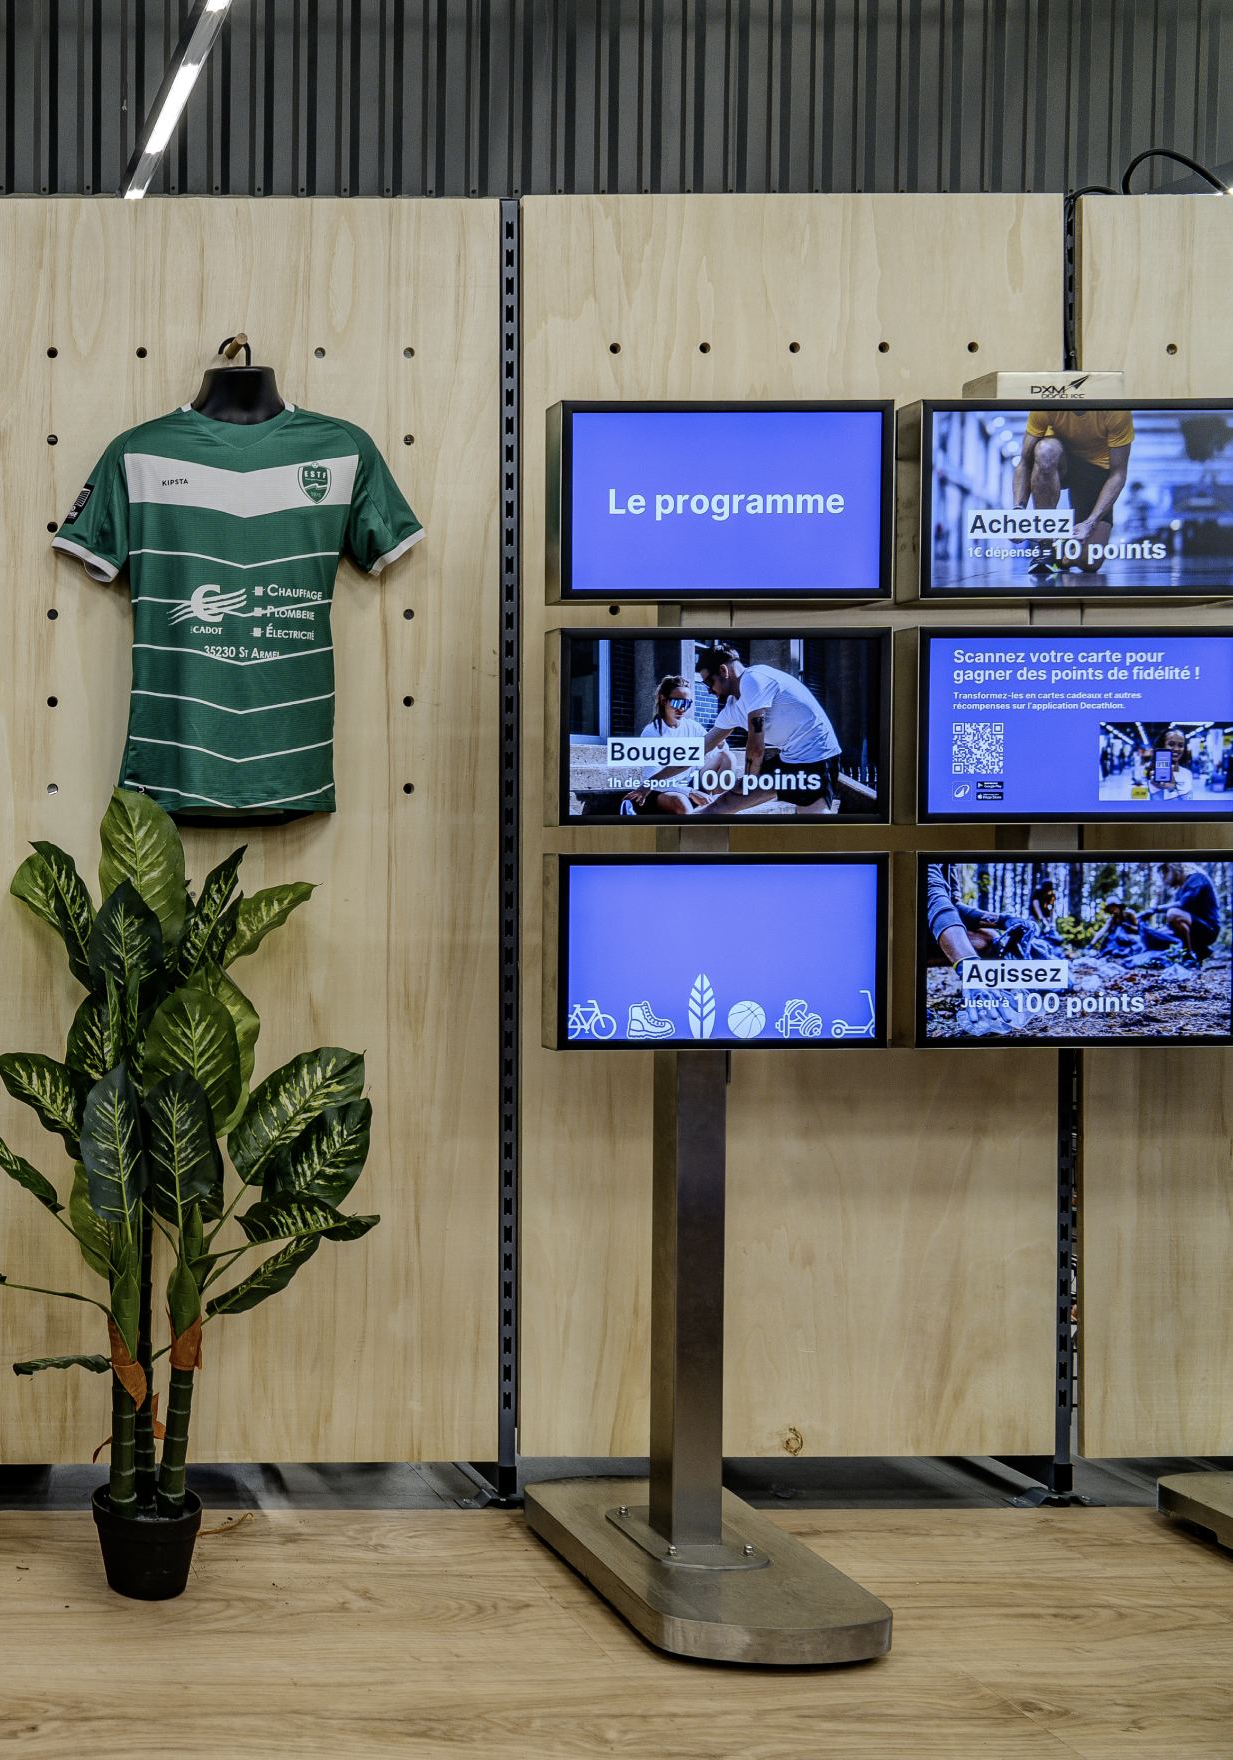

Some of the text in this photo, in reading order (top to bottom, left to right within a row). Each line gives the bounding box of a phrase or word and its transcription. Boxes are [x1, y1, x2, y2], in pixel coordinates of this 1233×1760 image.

[609, 488, 844, 522] Le programme
[970, 514, 1070, 534] Achetez
[968, 547, 981, 558] 1€
[985, 546, 1040, 561] dépensé
[1052, 540, 1081, 559] 10
[1088, 539, 1166, 564] points
[204, 646, 235, 658] 35230
[954, 650, 1164, 666] Scannez votre carte pour
[953, 669, 1012, 684] gagner
[1017, 667, 1046, 680] des
[1051, 667, 1103, 683] points
[1108, 667, 1128, 680] de
[1133, 666, 1190, 680] fidélité
[953, 702, 1010, 711] récompenses
[611, 742, 700, 765] Bougez
[608, 778, 621, 787] 1h
[624, 778, 640, 788] de
[643, 778, 676, 790] sport
[690, 770, 735, 790] 100
[742, 769, 820, 795] points
[966, 964, 1061, 987] Agissez
[1014, 993, 1060, 1013] 100
[1067, 992, 1144, 1017] points
